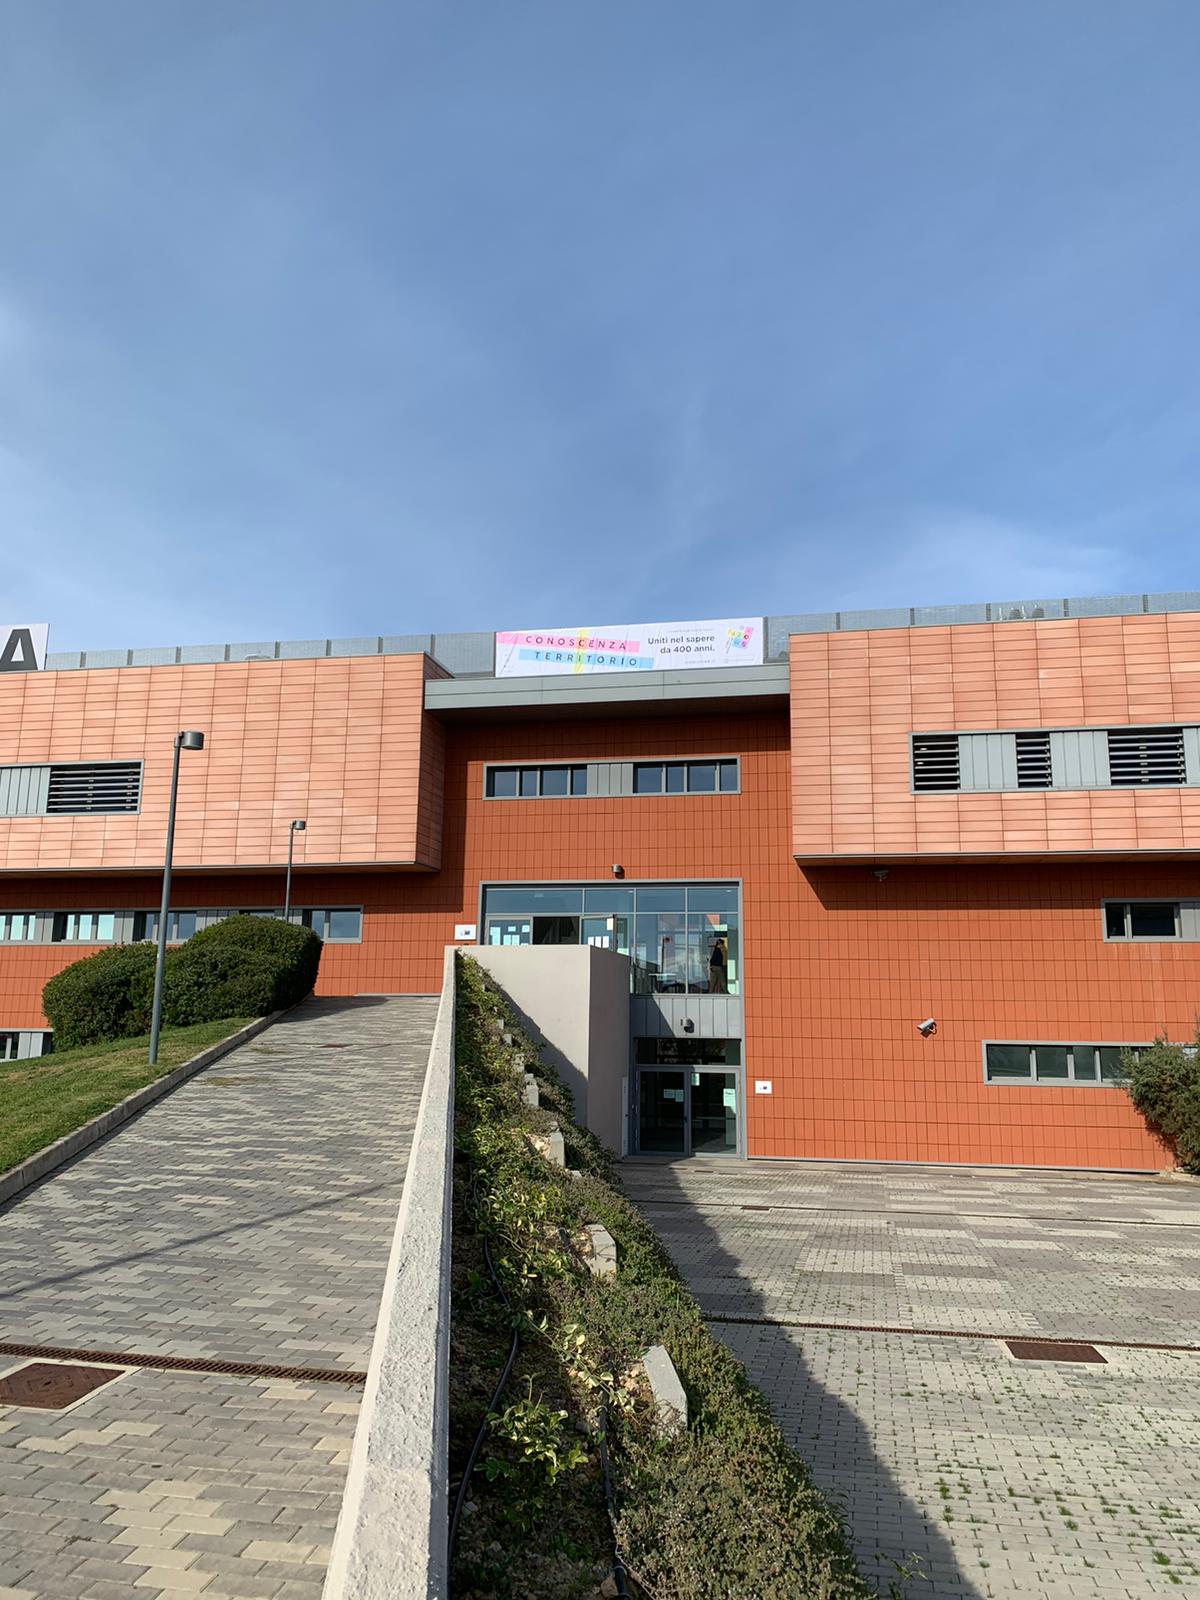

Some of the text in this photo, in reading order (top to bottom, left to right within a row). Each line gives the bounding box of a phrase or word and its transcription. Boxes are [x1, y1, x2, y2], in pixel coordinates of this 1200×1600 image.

[526, 636, 626, 650] CONOSCENZA
[648, 637, 668, 645] Uniti
[686, 635, 715, 643] sapere
[0, 629, 38, 671] A
[660, 644, 716, 654] da 400 anni.
[535, 651, 637, 666] TERRITORIO
